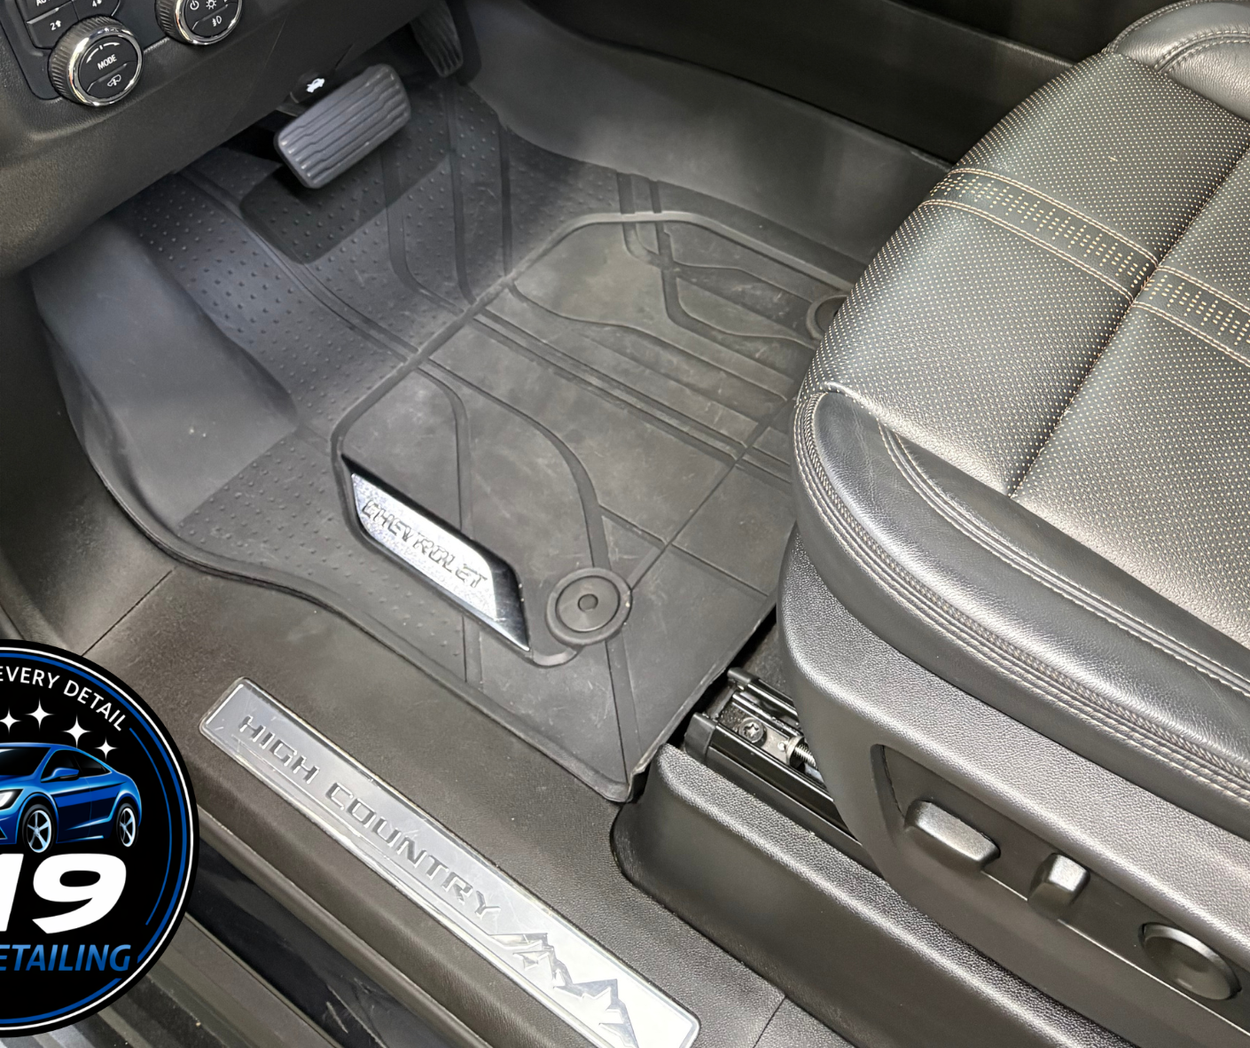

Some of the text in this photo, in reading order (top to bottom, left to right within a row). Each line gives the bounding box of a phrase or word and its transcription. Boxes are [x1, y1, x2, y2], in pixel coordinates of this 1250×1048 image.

[97, 53, 117, 71] MODE
[361, 499, 488, 589] CHEVROLET
[238, 714, 502, 920] HIGH COUNTRY
